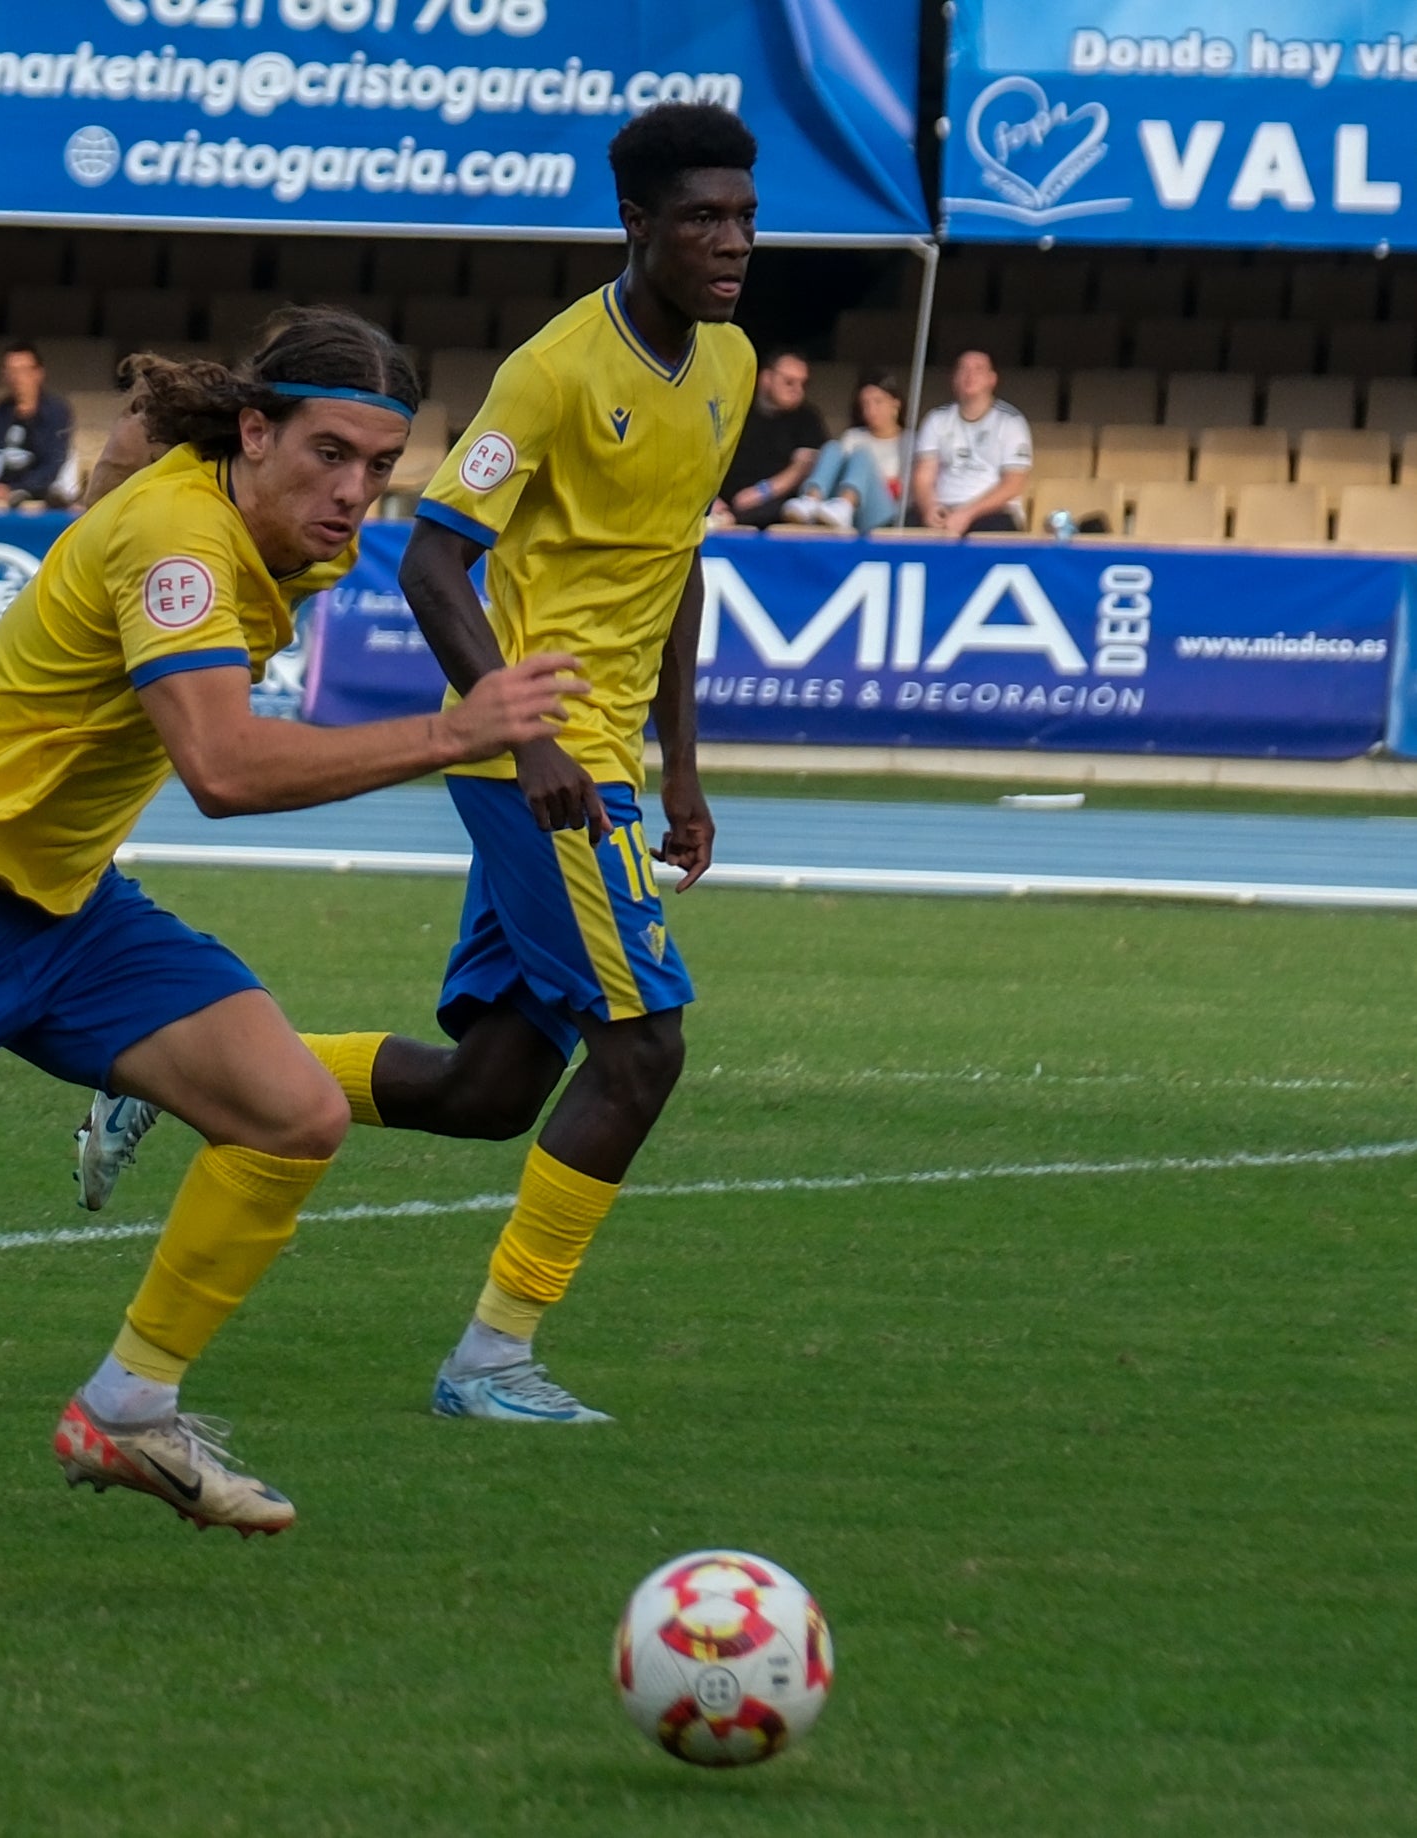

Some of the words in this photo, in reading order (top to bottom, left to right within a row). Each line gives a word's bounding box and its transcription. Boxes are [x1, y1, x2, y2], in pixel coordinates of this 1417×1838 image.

[1072, 27, 1236, 76] Donde
[1248, 29, 1342, 88] hay
[123, 129, 575, 202] cristogarcia.com
[1138, 119, 1402, 214] VAL
[696, 556, 1089, 677] MIA
[1093, 564, 1153, 677] DECO
[1176, 632, 1388, 663] www.miadeco.es
[856, 680, 882, 710] &
[895, 681, 1145, 717] DECORACIÓN
